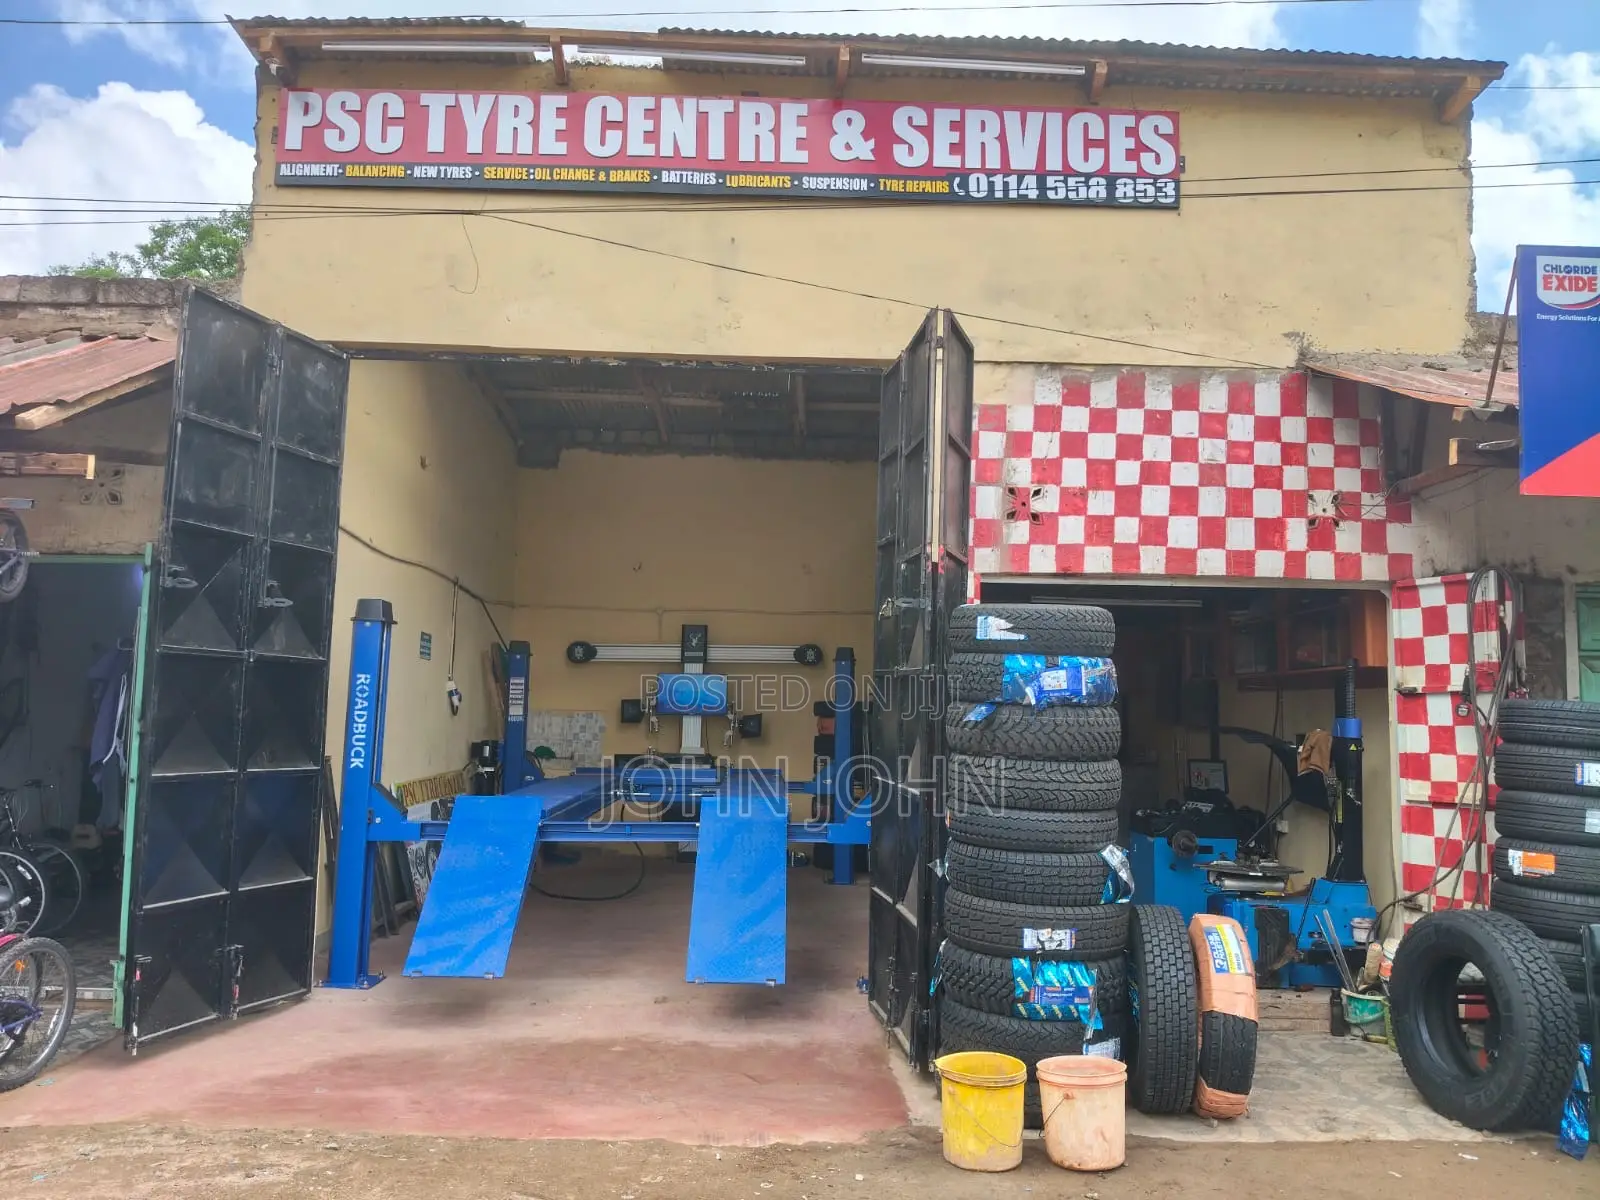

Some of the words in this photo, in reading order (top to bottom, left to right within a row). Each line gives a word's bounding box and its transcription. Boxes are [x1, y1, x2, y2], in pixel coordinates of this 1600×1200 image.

[284, 91, 405, 154] PSC
[421, 94, 568, 156] TYRE
[584, 96, 809, 163] CENTRE
[829, 109, 875, 162] &
[892, 106, 1177, 175] SERVICES
[280, 163, 340, 176] ALIGNMENT
[345, 165, 405, 177] BALANCING
[413, 165, 438, 178] NEW
[440, 166, 473, 179] TYRES
[553, 168, 595, 180] CHANGE
[599, 171, 606, 181] &
[610, 170, 651, 182] BRAKES
[661, 171, 717, 184] BATTERIES
[726, 174, 792, 188] LUBRICANTS
[802, 176, 868, 190] SUSPENSION
[879, 178, 905, 191] TYRE
[906, 180, 950, 193] REPAIRS
[968, 173, 1039, 199] 0114
[1046, 176, 1107, 202] 558
[1115, 178, 1176, 203] 853
[1542, 274, 1598, 292] EXIDE
[1543, 264, 1598, 274] CHLORIDE
[1536, 313, 1557, 321] Energy
[350, 673, 371, 769] ROADBUCK
